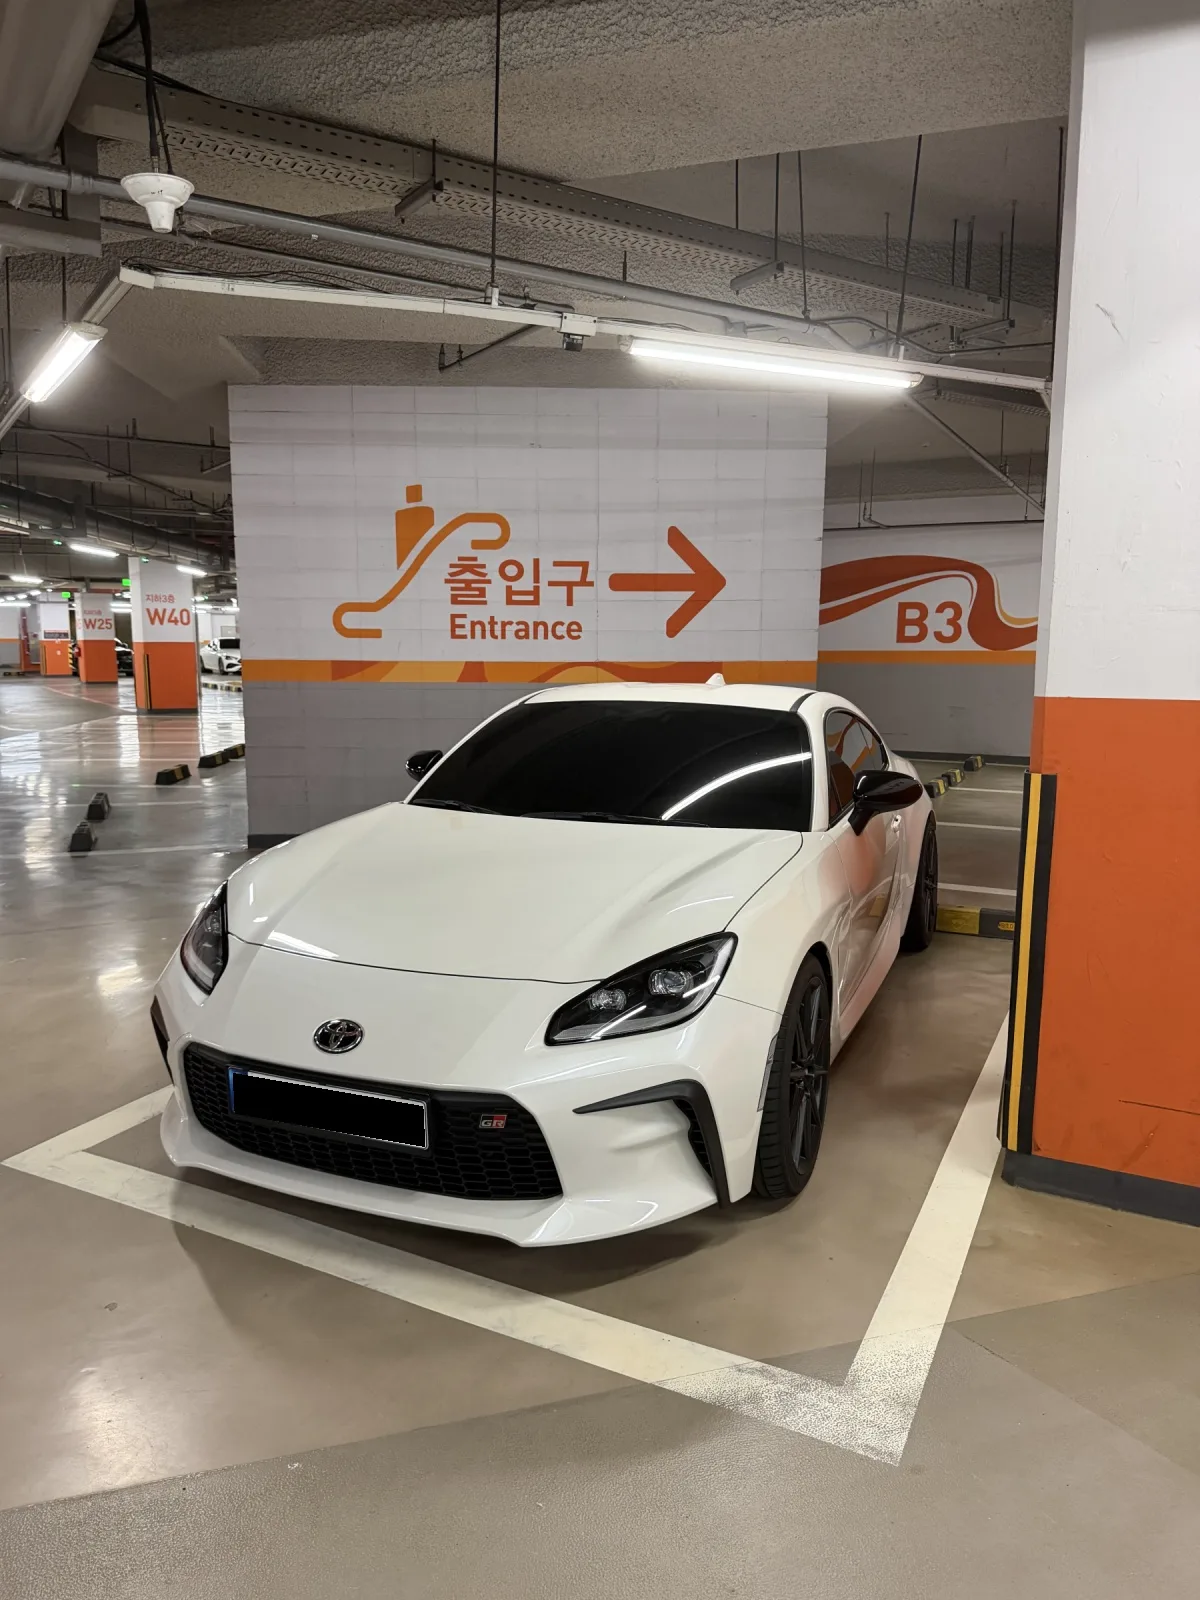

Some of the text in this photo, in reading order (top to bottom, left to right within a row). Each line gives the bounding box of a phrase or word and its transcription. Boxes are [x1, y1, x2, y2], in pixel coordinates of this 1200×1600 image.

[444, 556, 595, 607] 출입구
[83, 618, 113, 630] W25
[146, 608, 191, 626] W40
[449, 613, 583, 640] Entrance
[896, 601, 963, 644] B3
